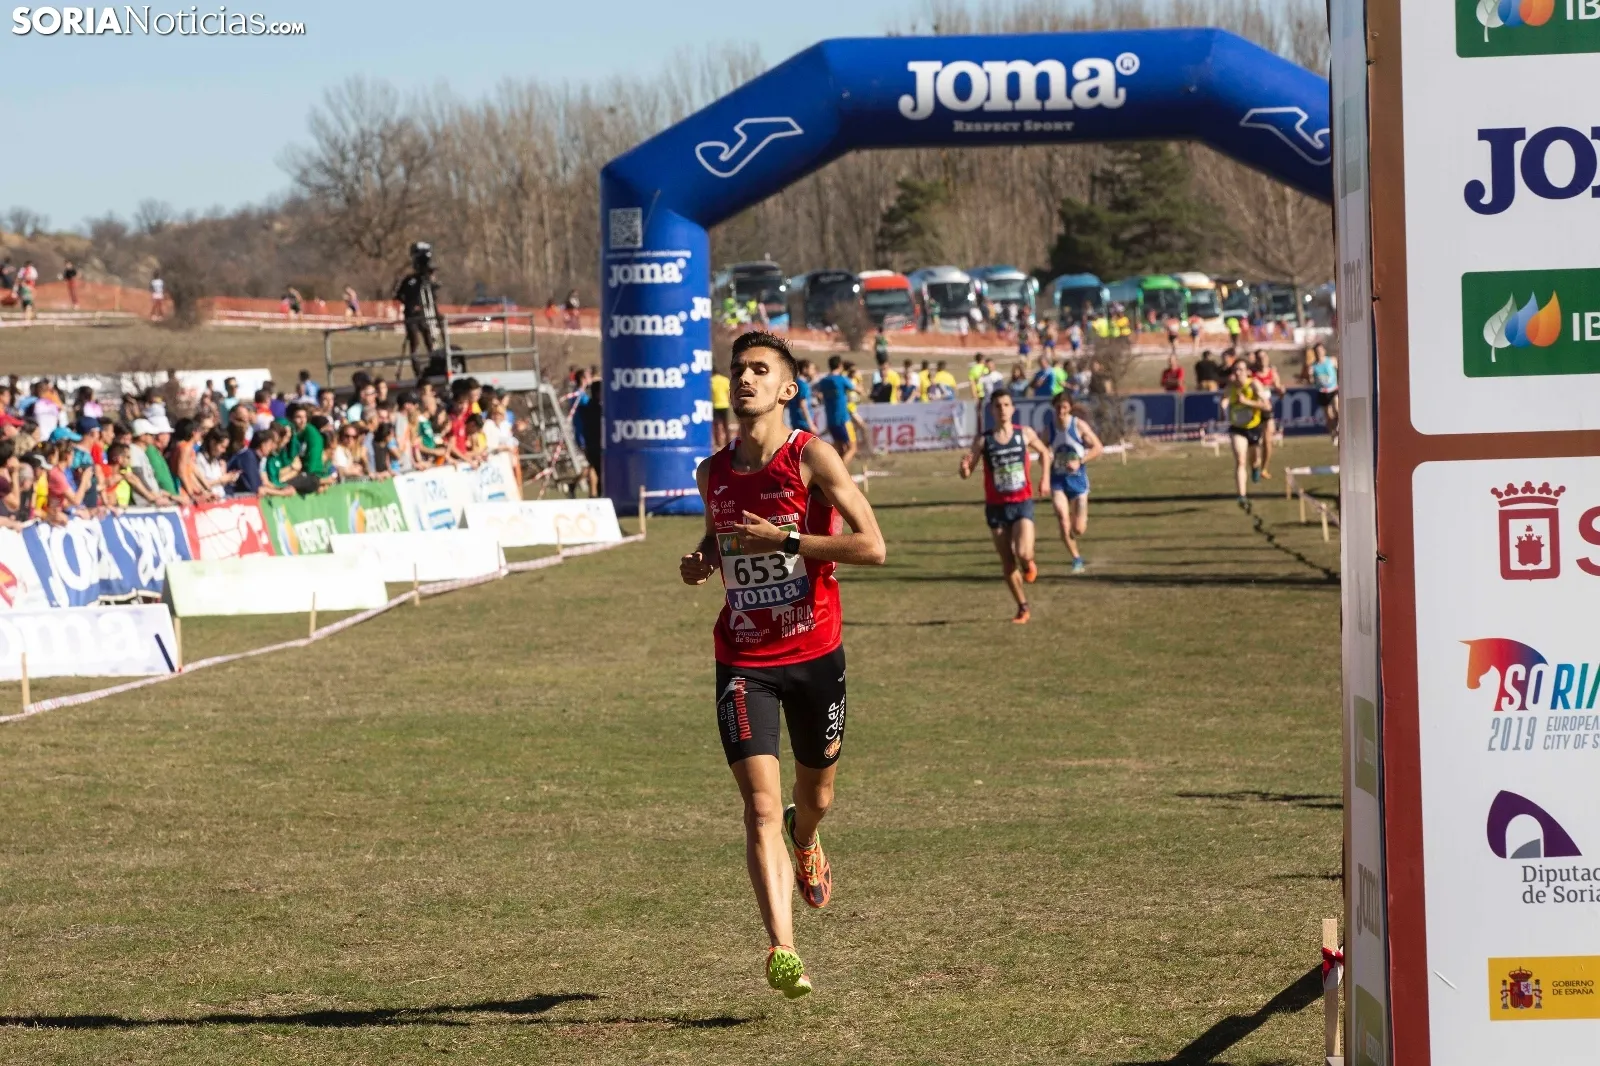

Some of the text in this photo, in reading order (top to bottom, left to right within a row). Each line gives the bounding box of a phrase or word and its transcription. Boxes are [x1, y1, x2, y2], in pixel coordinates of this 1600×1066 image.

[1464, 126, 1600, 215] JO
[734, 553, 790, 586] 653
[1488, 716, 1538, 751] 2019
[1543, 734, 1571, 751] CITY
[1573, 733, 1590, 750] OF
[1522, 884, 1600, 904] de Soria
[1552, 979, 1595, 987] GOBIERNO
[1564, 987, 1595, 995] ESPAÑA
